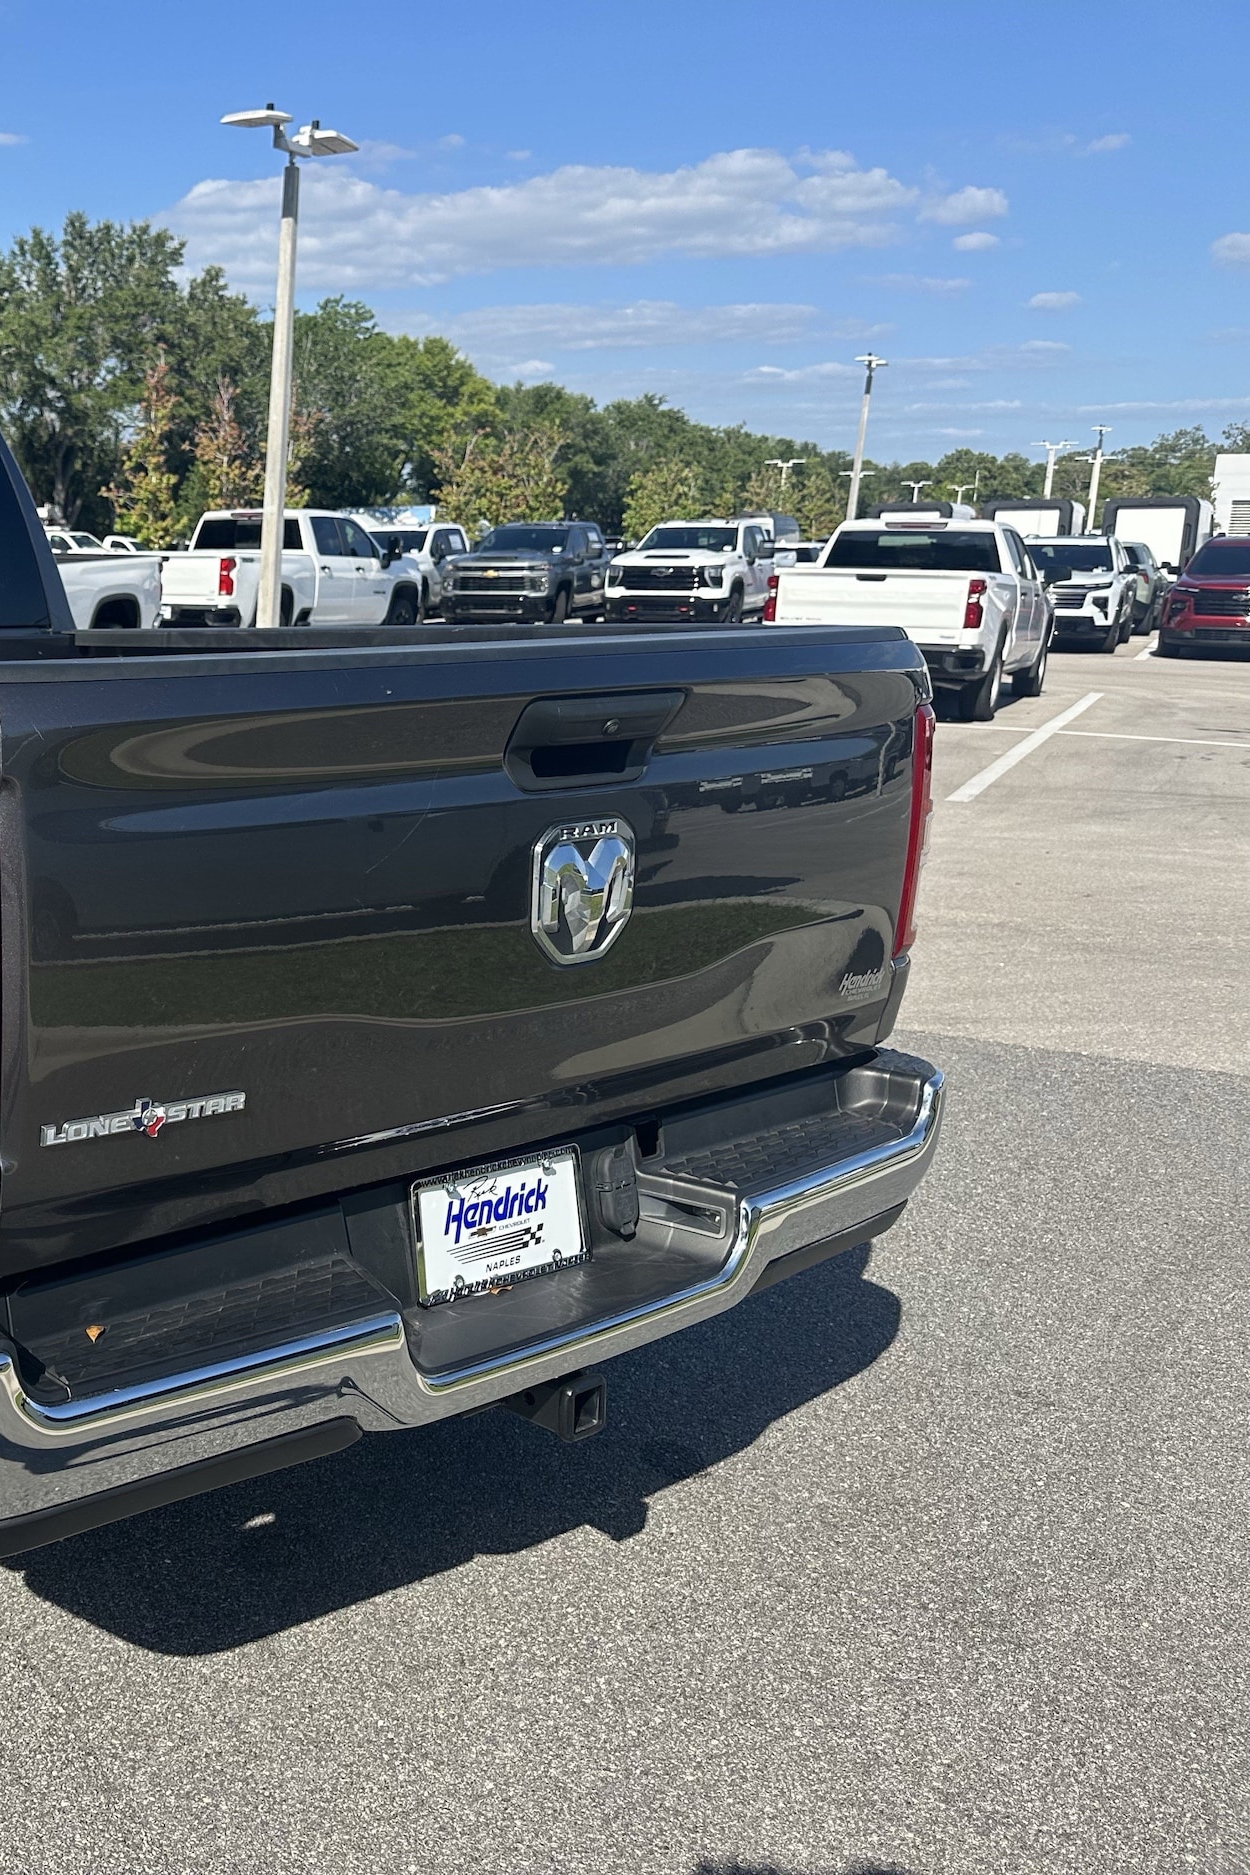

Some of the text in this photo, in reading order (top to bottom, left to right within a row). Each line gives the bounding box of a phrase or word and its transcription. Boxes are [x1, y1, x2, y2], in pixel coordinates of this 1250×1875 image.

[560, 821, 618, 840] RAM
[839, 968, 885, 996] Hendrick
[40, 1090, 246, 1147] LONE STAR
[444, 1178, 548, 1244] Hendrick
[499, 1218, 531, 1231] CHEVROLET
[485, 1255, 521, 1272] NAPLES
